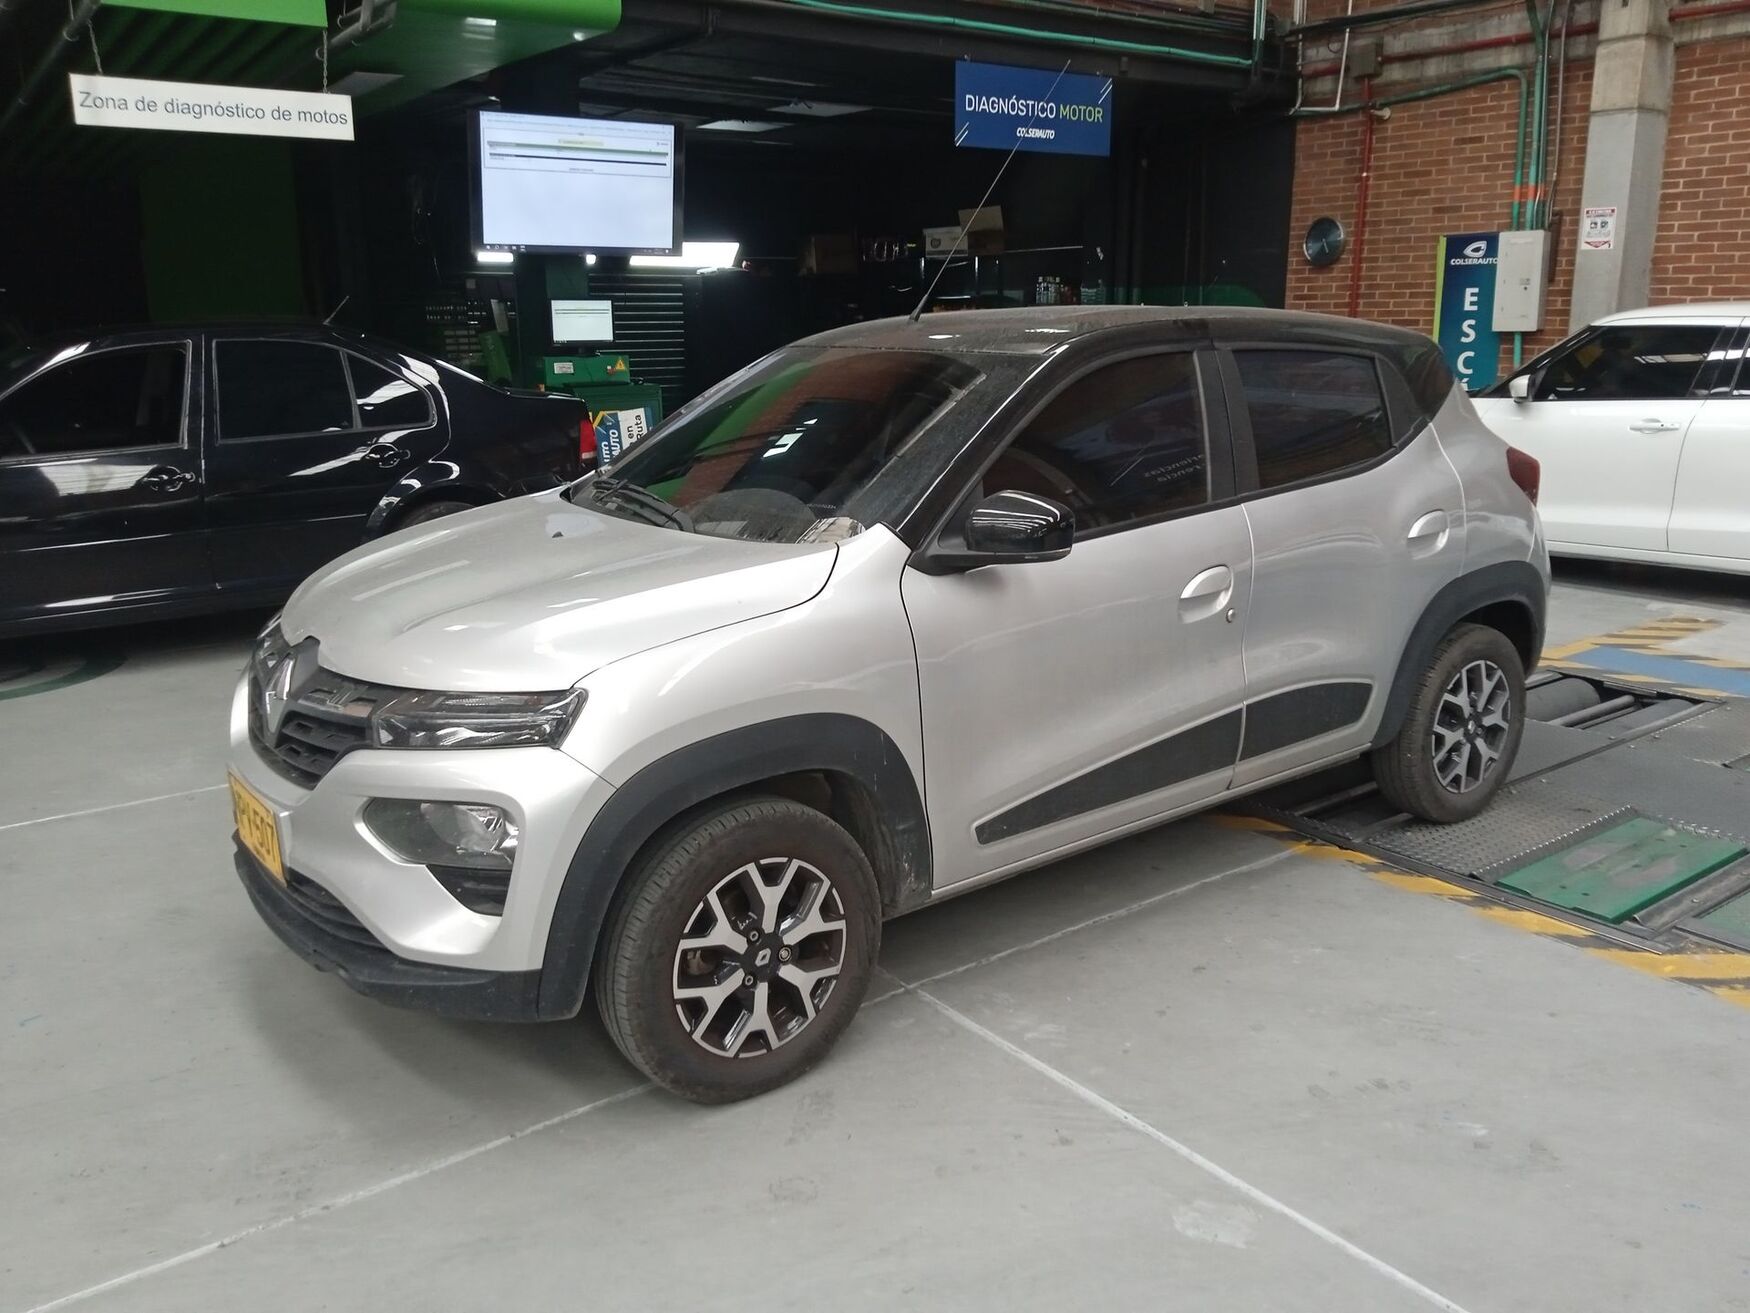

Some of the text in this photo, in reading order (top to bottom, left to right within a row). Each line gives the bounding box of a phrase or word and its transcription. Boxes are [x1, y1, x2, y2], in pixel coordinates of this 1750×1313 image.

[79, 91, 348, 125] Zona de diagnóstico de motos
[965, 94, 1103, 123] DIAGNÓSTICO MOTOR
[1016, 127, 1056, 140] COLSERAUTO
